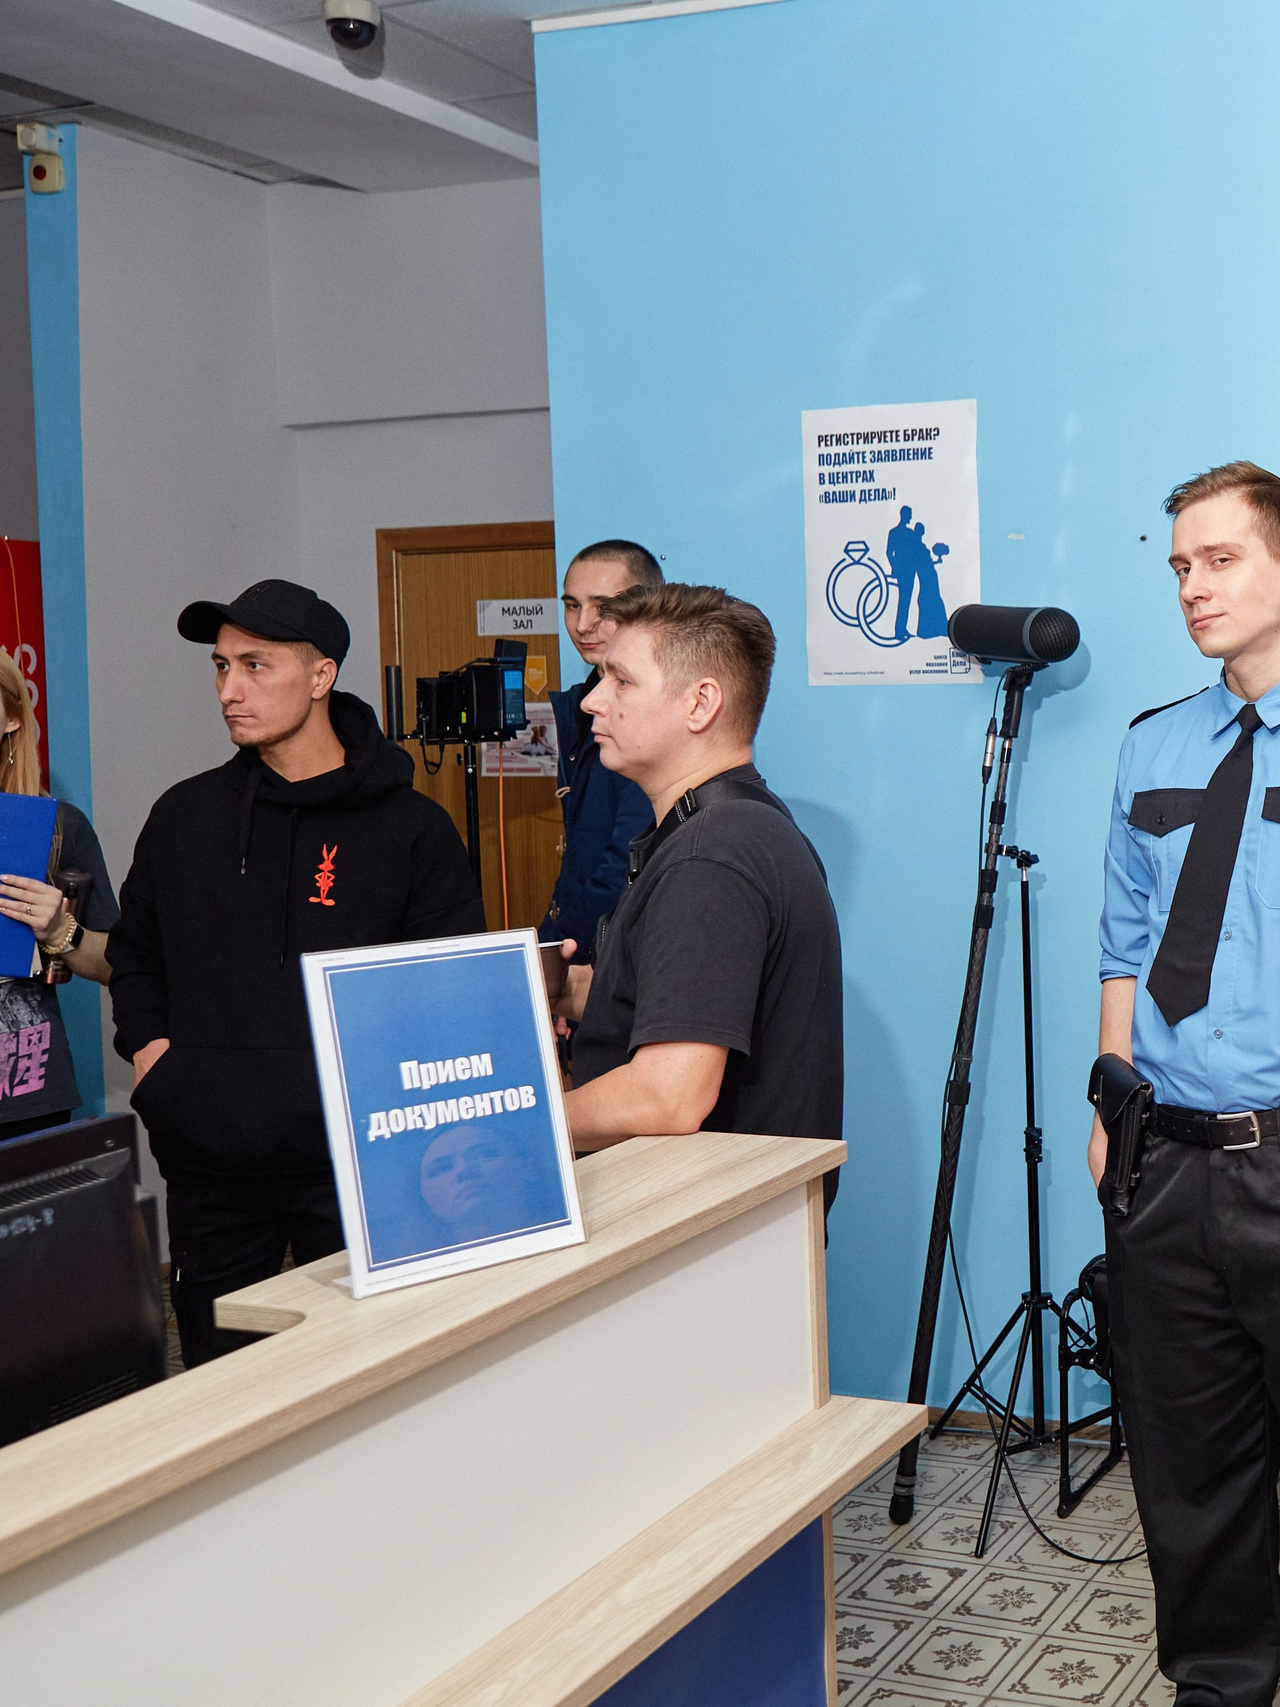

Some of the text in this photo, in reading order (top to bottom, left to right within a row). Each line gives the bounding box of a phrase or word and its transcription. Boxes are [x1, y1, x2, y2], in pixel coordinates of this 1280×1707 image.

[817, 427, 940, 448] РЕГИСТРИРУЕТЕ БРАК?
[818, 446, 933, 467] ПОДАЙТЕ ЗАЯВЛЕНИЕ
[818, 469, 875, 486] В ЦЕНТРАХ
[819, 487, 896, 504] «ВАШИ ДЕЛА»!
[501, 604, 543, 617] МАЛЫЙ
[512, 619, 533, 630] ЗАЛ
[400, 1053, 494, 1090] Прием
[367, 1085, 537, 1142] документов
